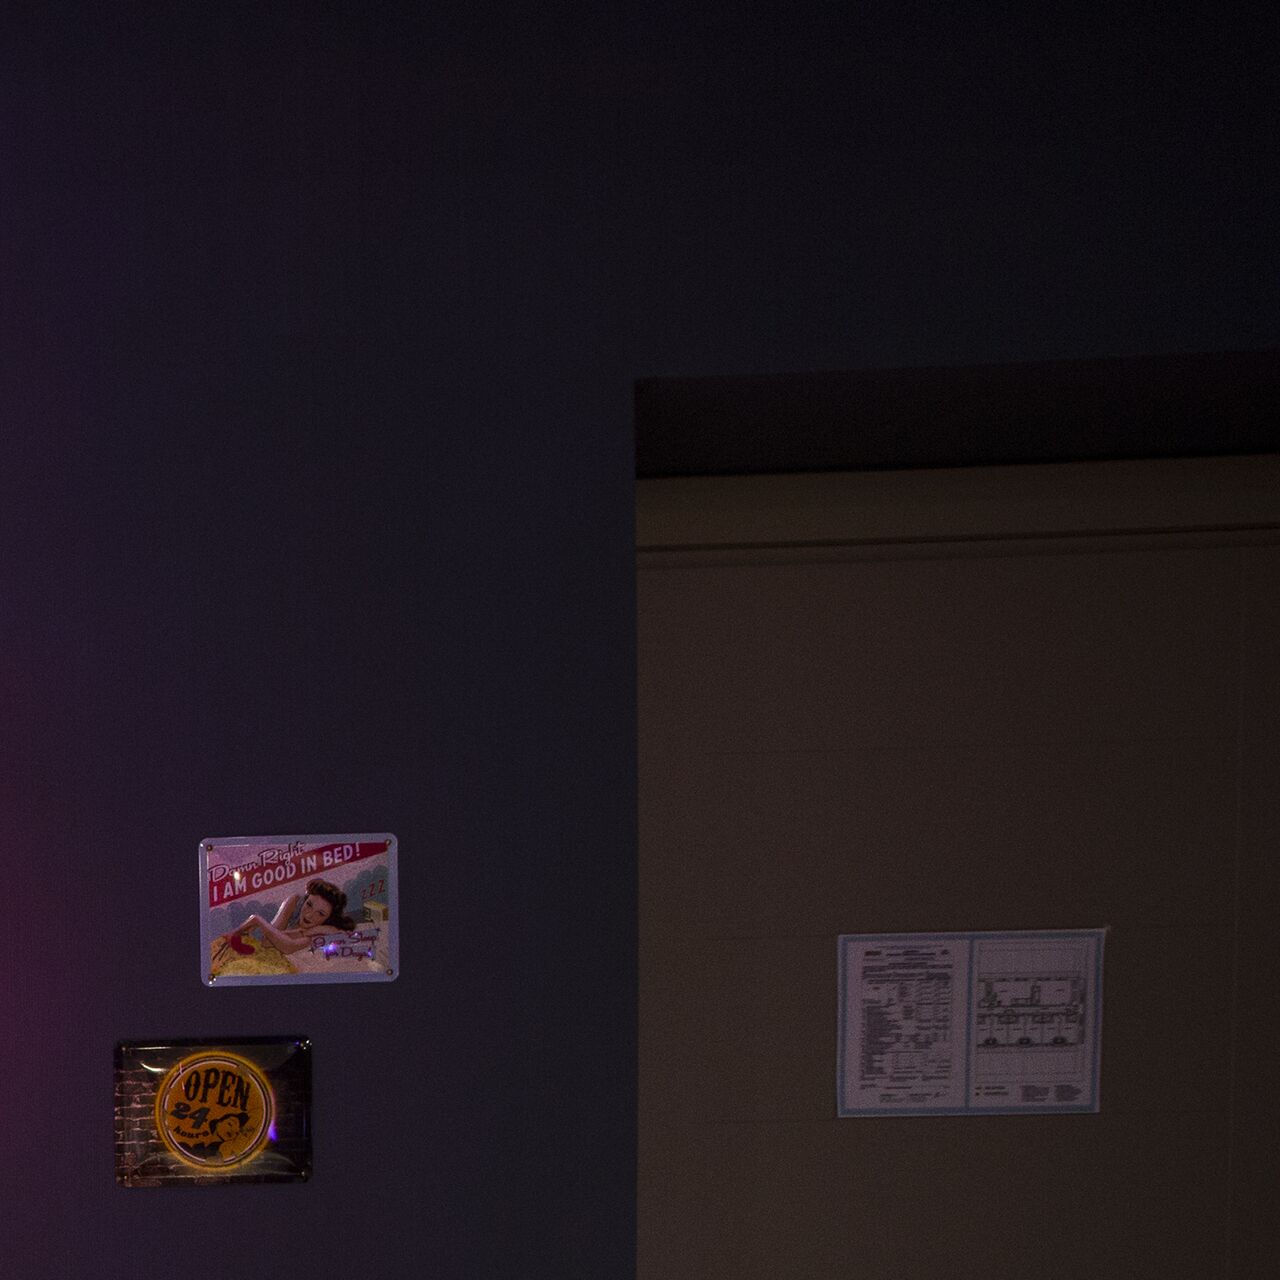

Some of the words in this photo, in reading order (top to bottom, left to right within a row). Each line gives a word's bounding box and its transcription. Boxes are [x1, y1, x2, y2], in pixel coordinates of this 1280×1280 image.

[258, 841, 304, 867] Right
[213, 885, 218, 902] I
[223, 876, 247, 899] AM
[252, 863, 297, 889] GOOD
[301, 854, 317, 873] IN
[323, 843, 360, 867] BED!
[184, 1068, 250, 1111] OPEN
[171, 1102, 210, 1129] 24
